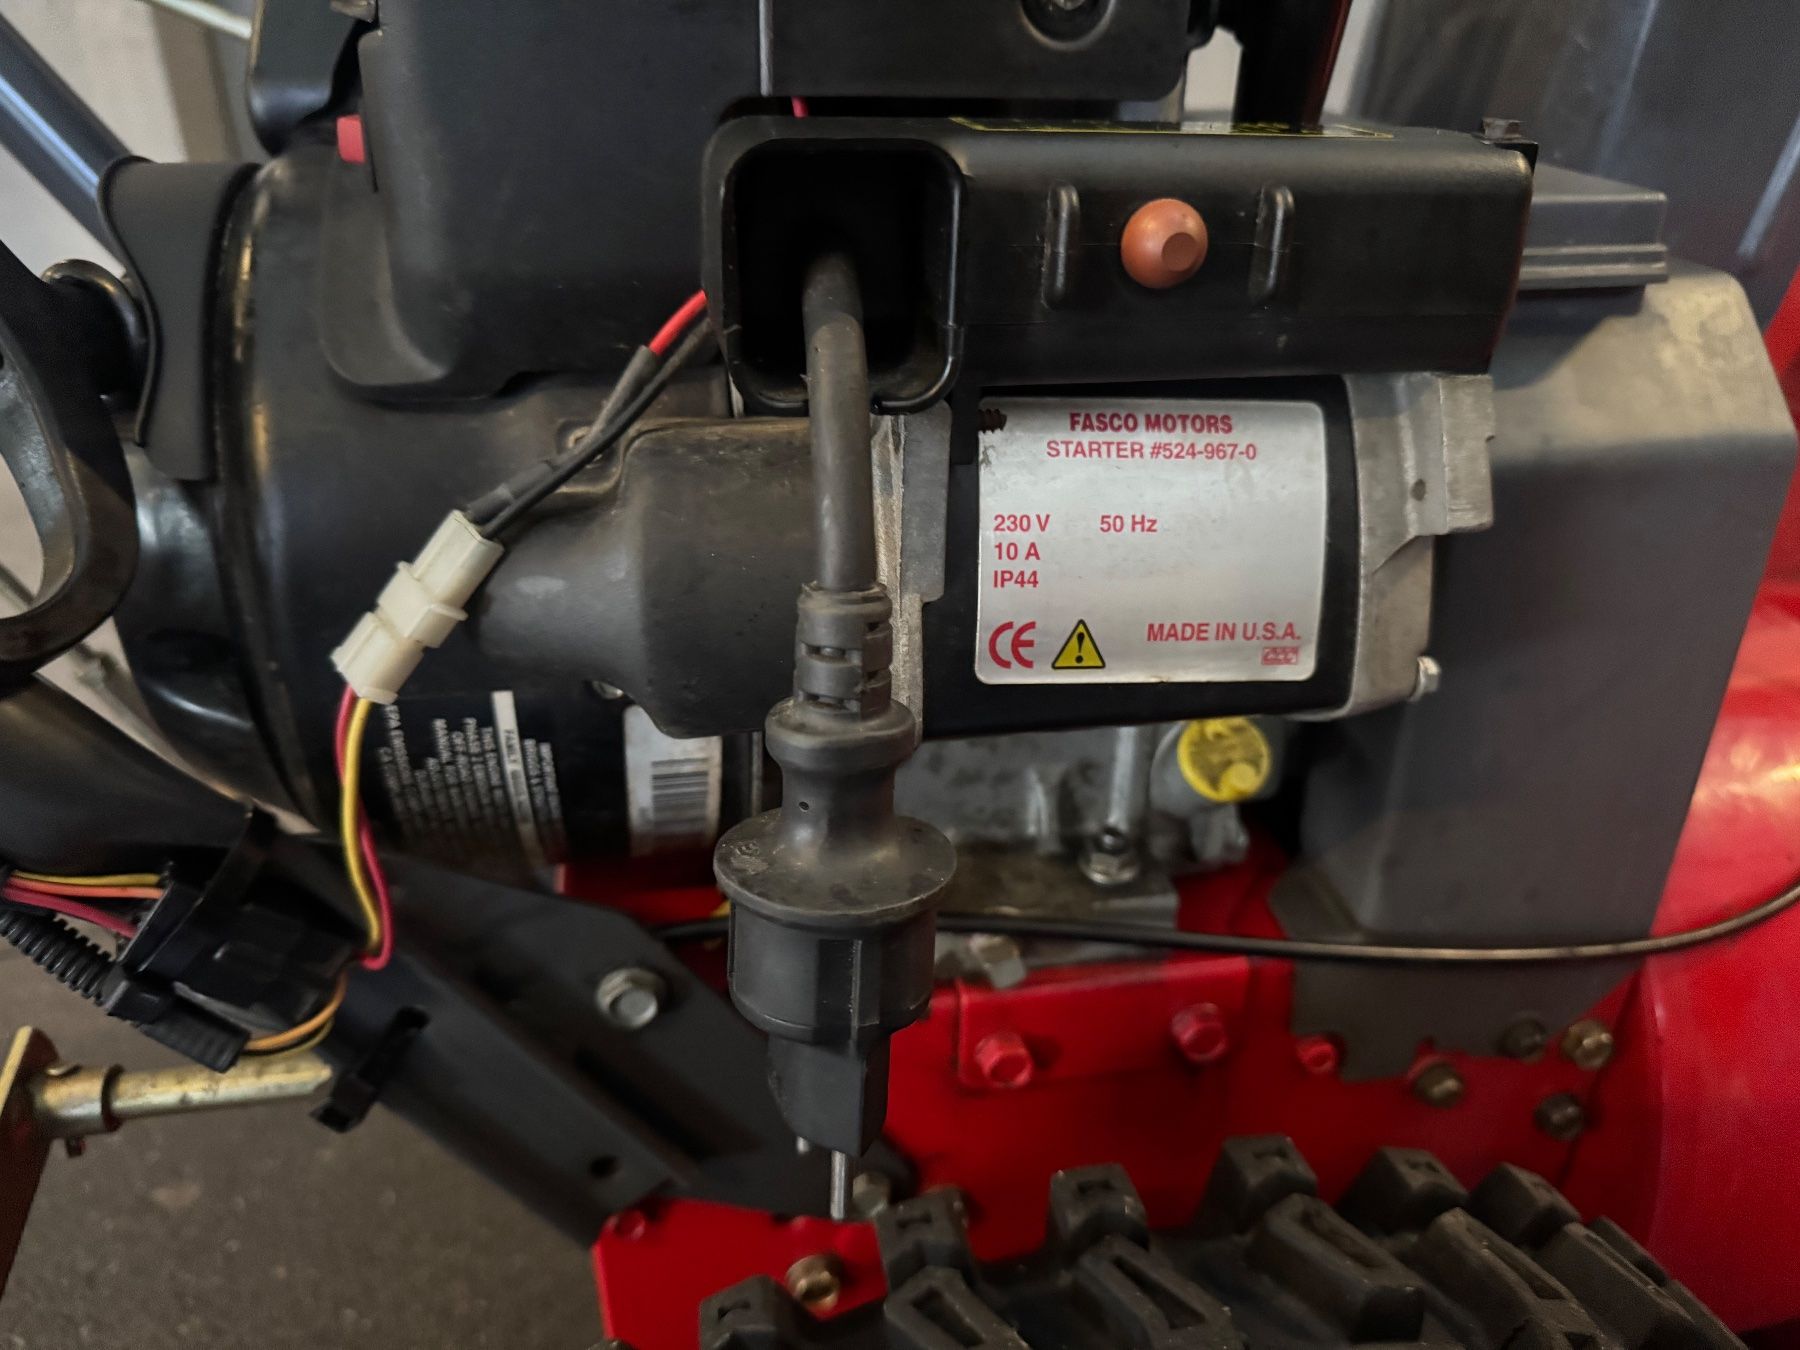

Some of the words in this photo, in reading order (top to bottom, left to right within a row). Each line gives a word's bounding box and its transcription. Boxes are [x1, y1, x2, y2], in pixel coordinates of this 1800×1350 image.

[1069, 413, 1139, 432] FASCO
[1145, 414, 1233, 433] MOTORS
[1046, 441, 1144, 459] STARTER
[1150, 442, 1257, 460] #524-967-0
[993, 515, 1031, 533] 230
[1035, 514, 1051, 532] V
[1099, 515, 1125, 533] 50
[1131, 515, 1158, 533] Hz
[994, 542, 1019, 560] 10
[1025, 543, 1041, 560] A
[993, 570, 1040, 588] IP44
[1147, 623, 1209, 641] MADE
[1215, 623, 1238, 641] IN
[1242, 623, 1302, 641] U.S.A.
[988, 620, 1037, 669] CE
